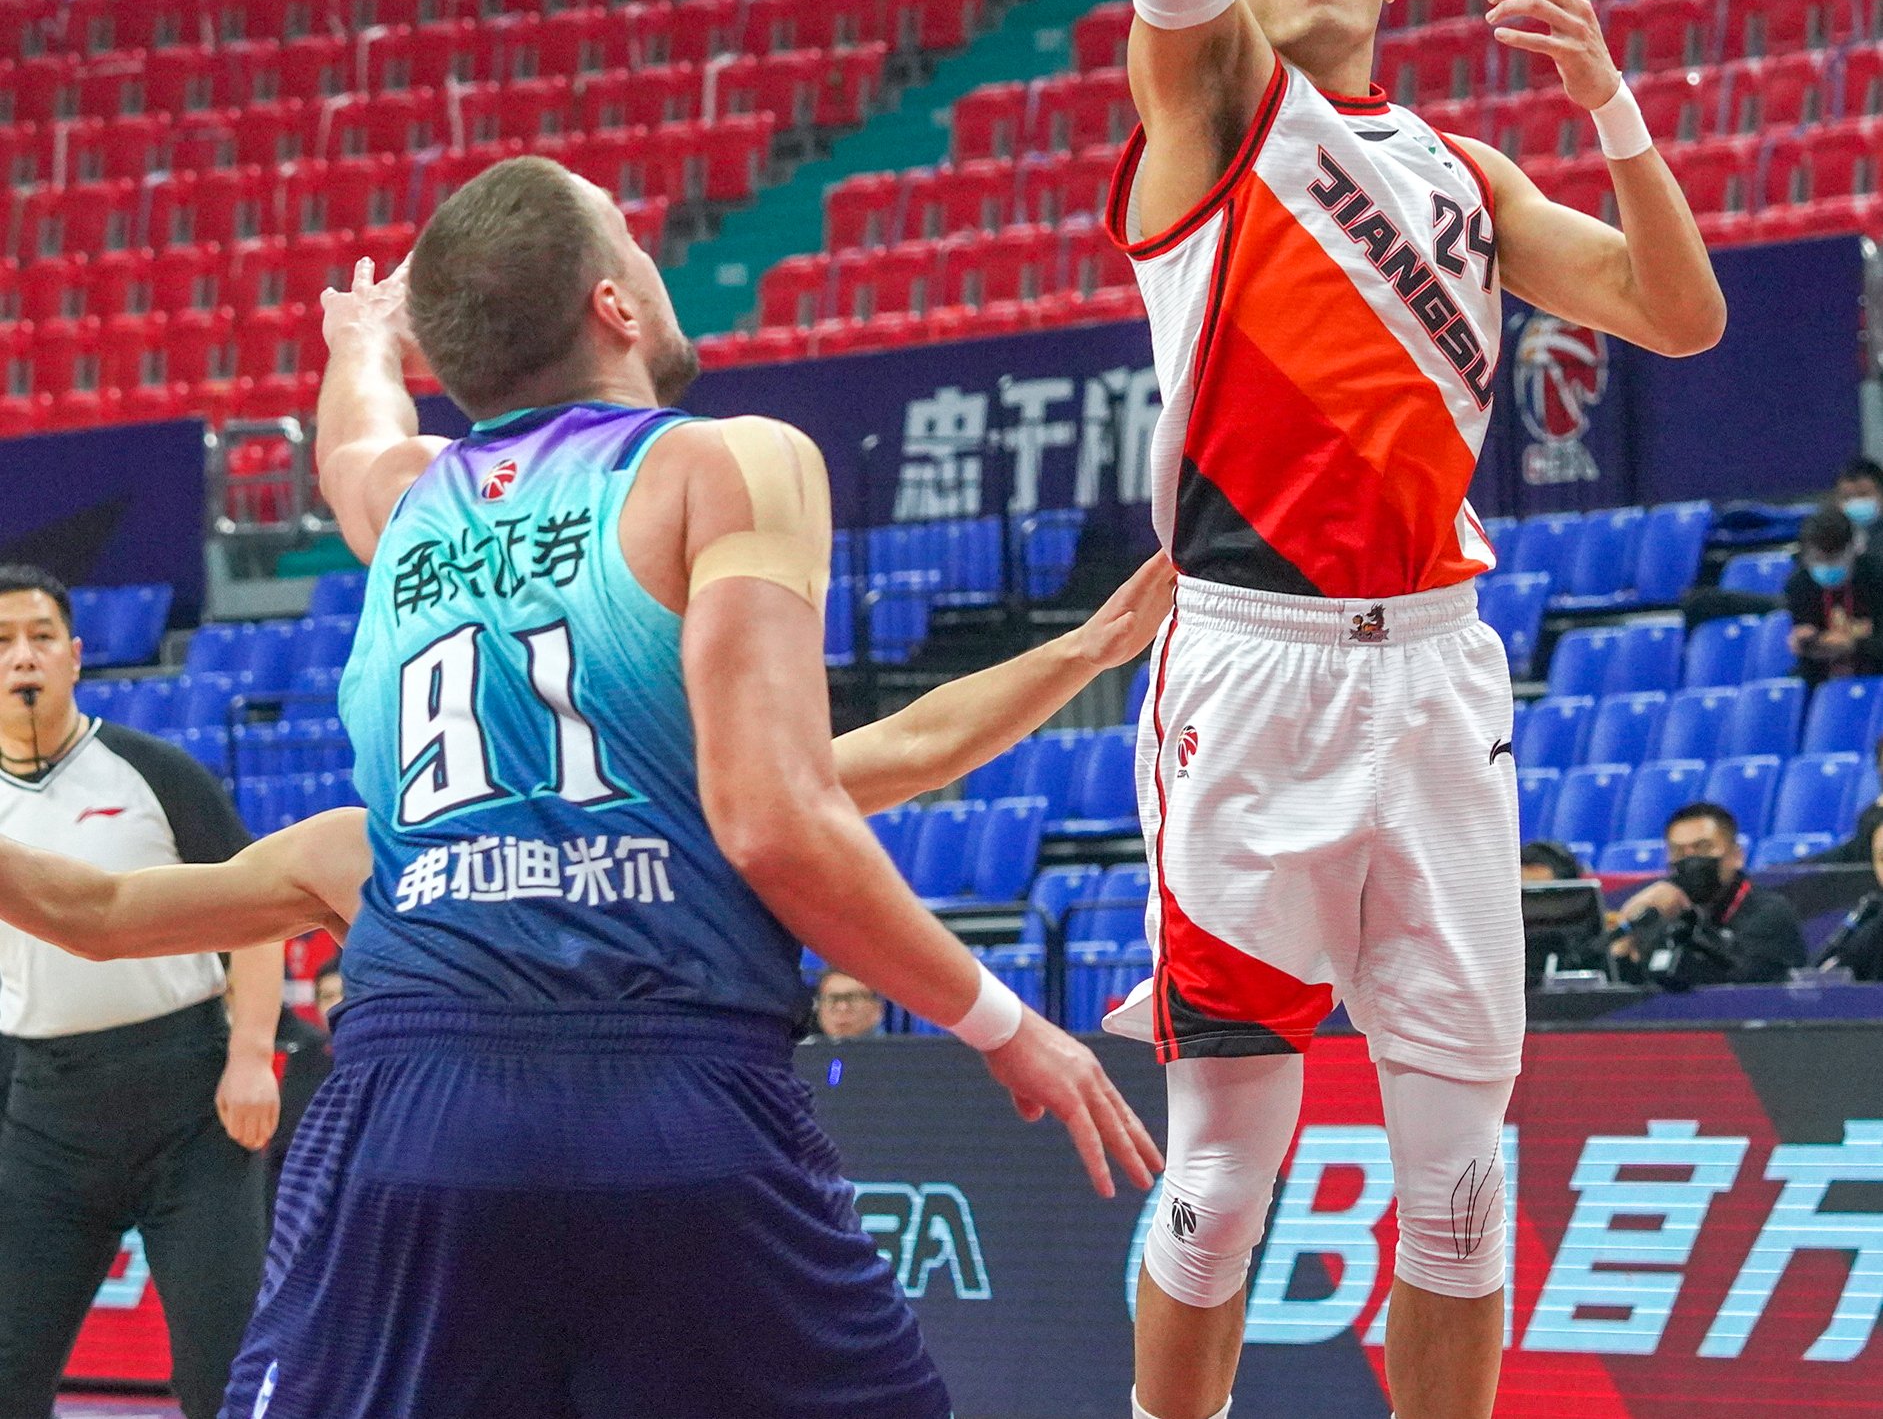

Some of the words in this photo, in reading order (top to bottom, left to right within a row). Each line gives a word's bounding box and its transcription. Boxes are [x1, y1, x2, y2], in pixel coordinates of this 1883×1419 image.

[1306, 144, 1494, 412] JIANGSU
[1429, 189, 1497, 295] 24
[397, 616, 642, 829] 91
[396, 834, 675, 913] 弗拉迪米尔
